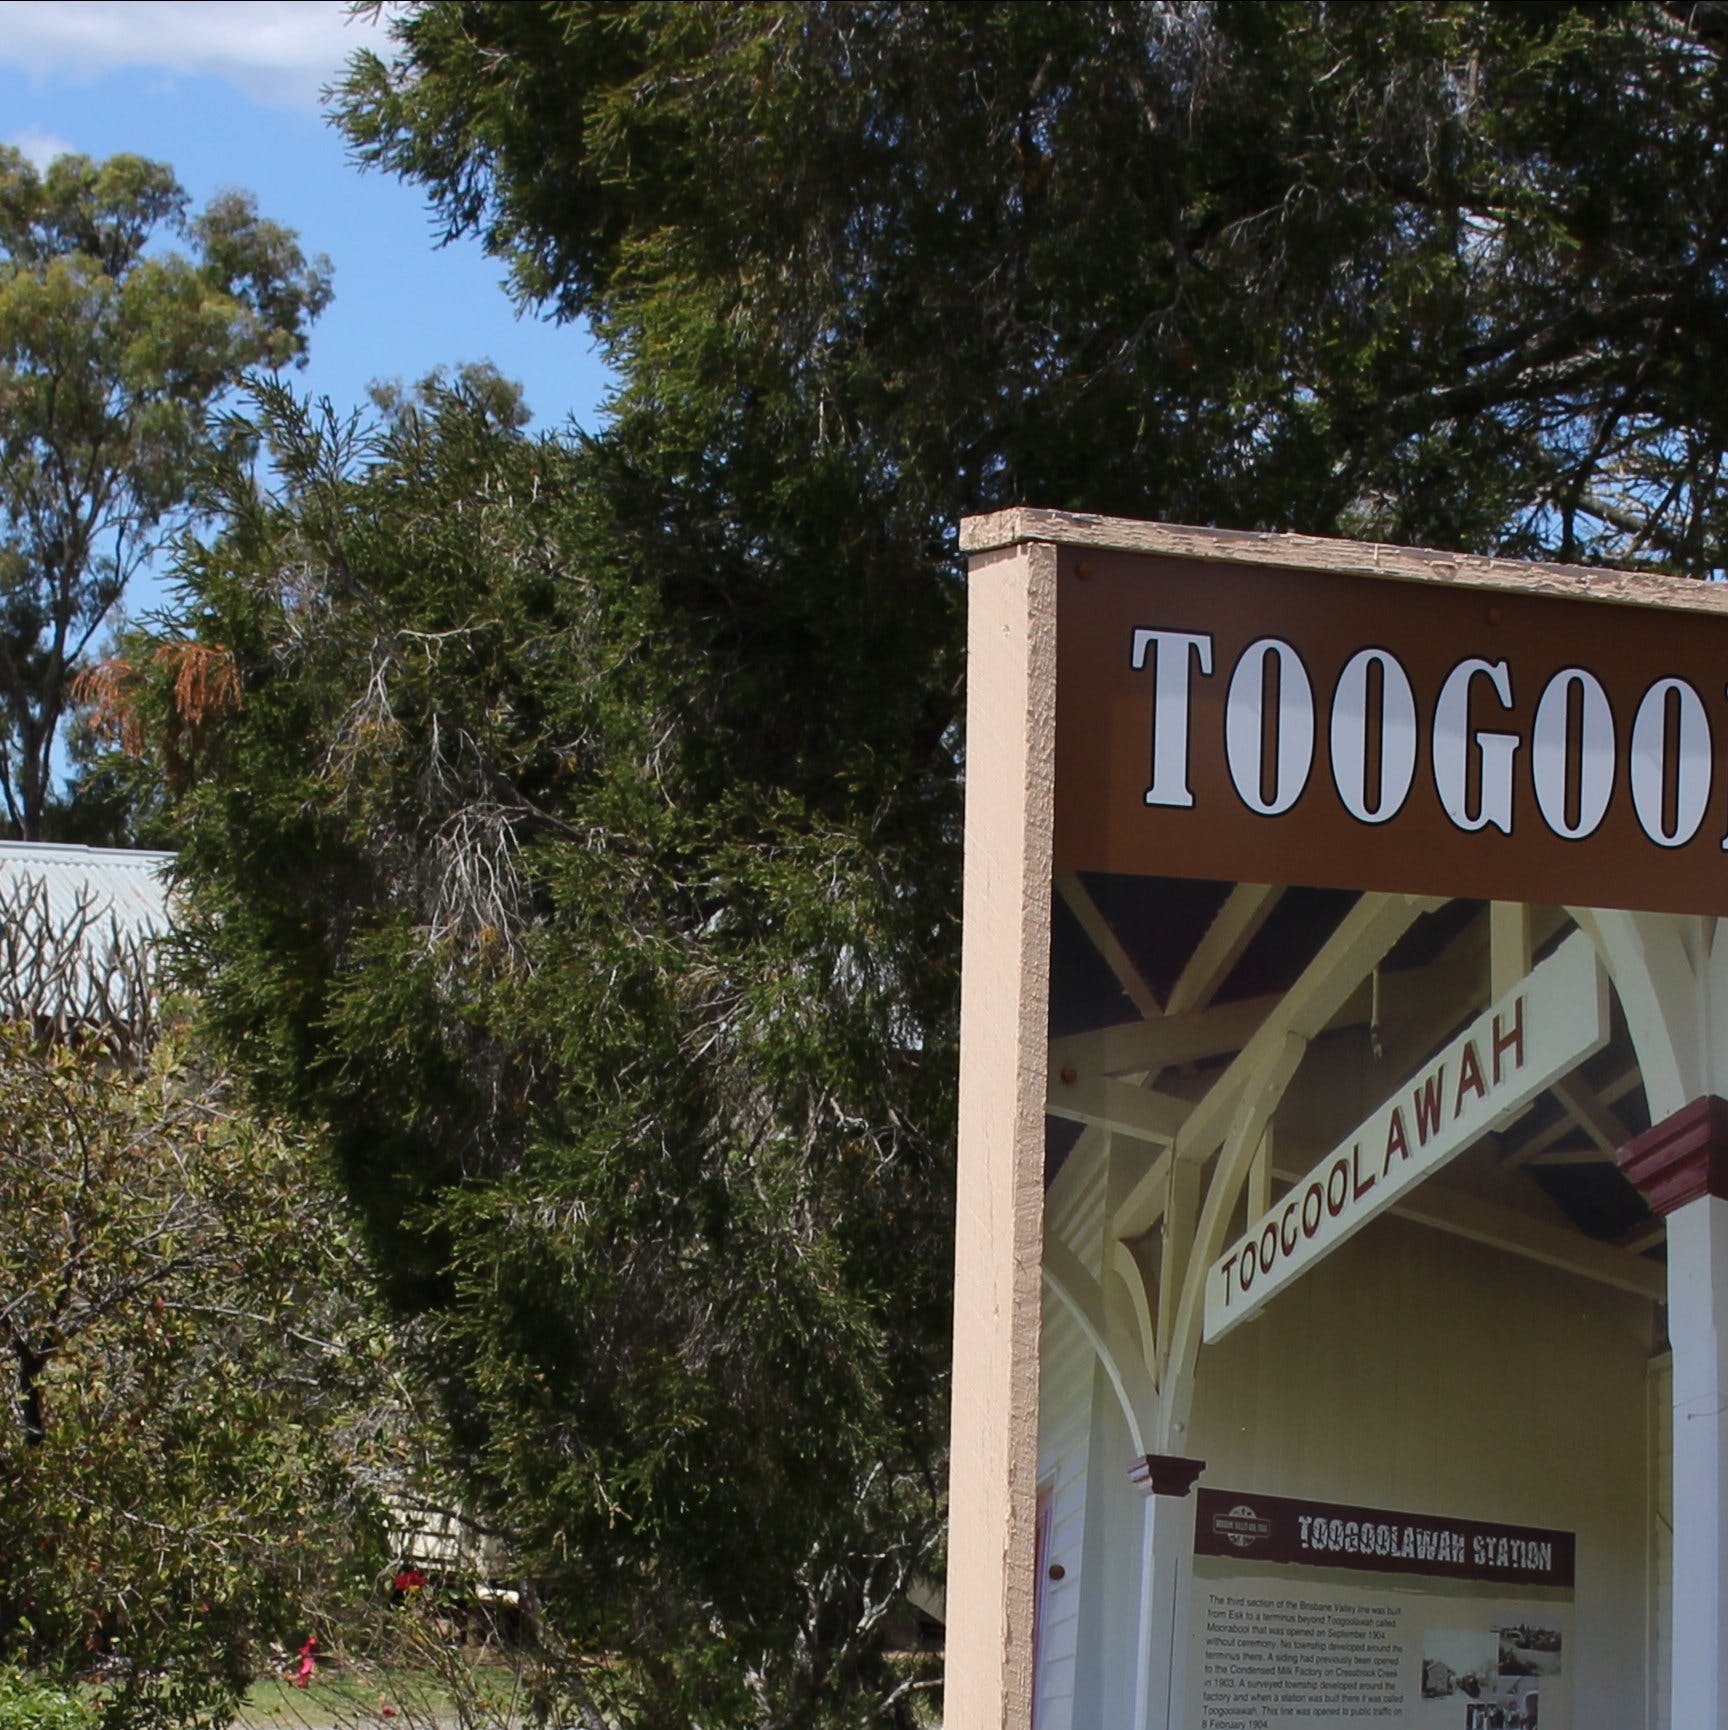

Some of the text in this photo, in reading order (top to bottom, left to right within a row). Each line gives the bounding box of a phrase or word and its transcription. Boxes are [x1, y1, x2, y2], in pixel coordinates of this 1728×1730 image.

[1221, 996, 1525, 1307] TOOGOOLAWAH
[1298, 1515, 1553, 1572] TOOGOOLAWAH STATION
